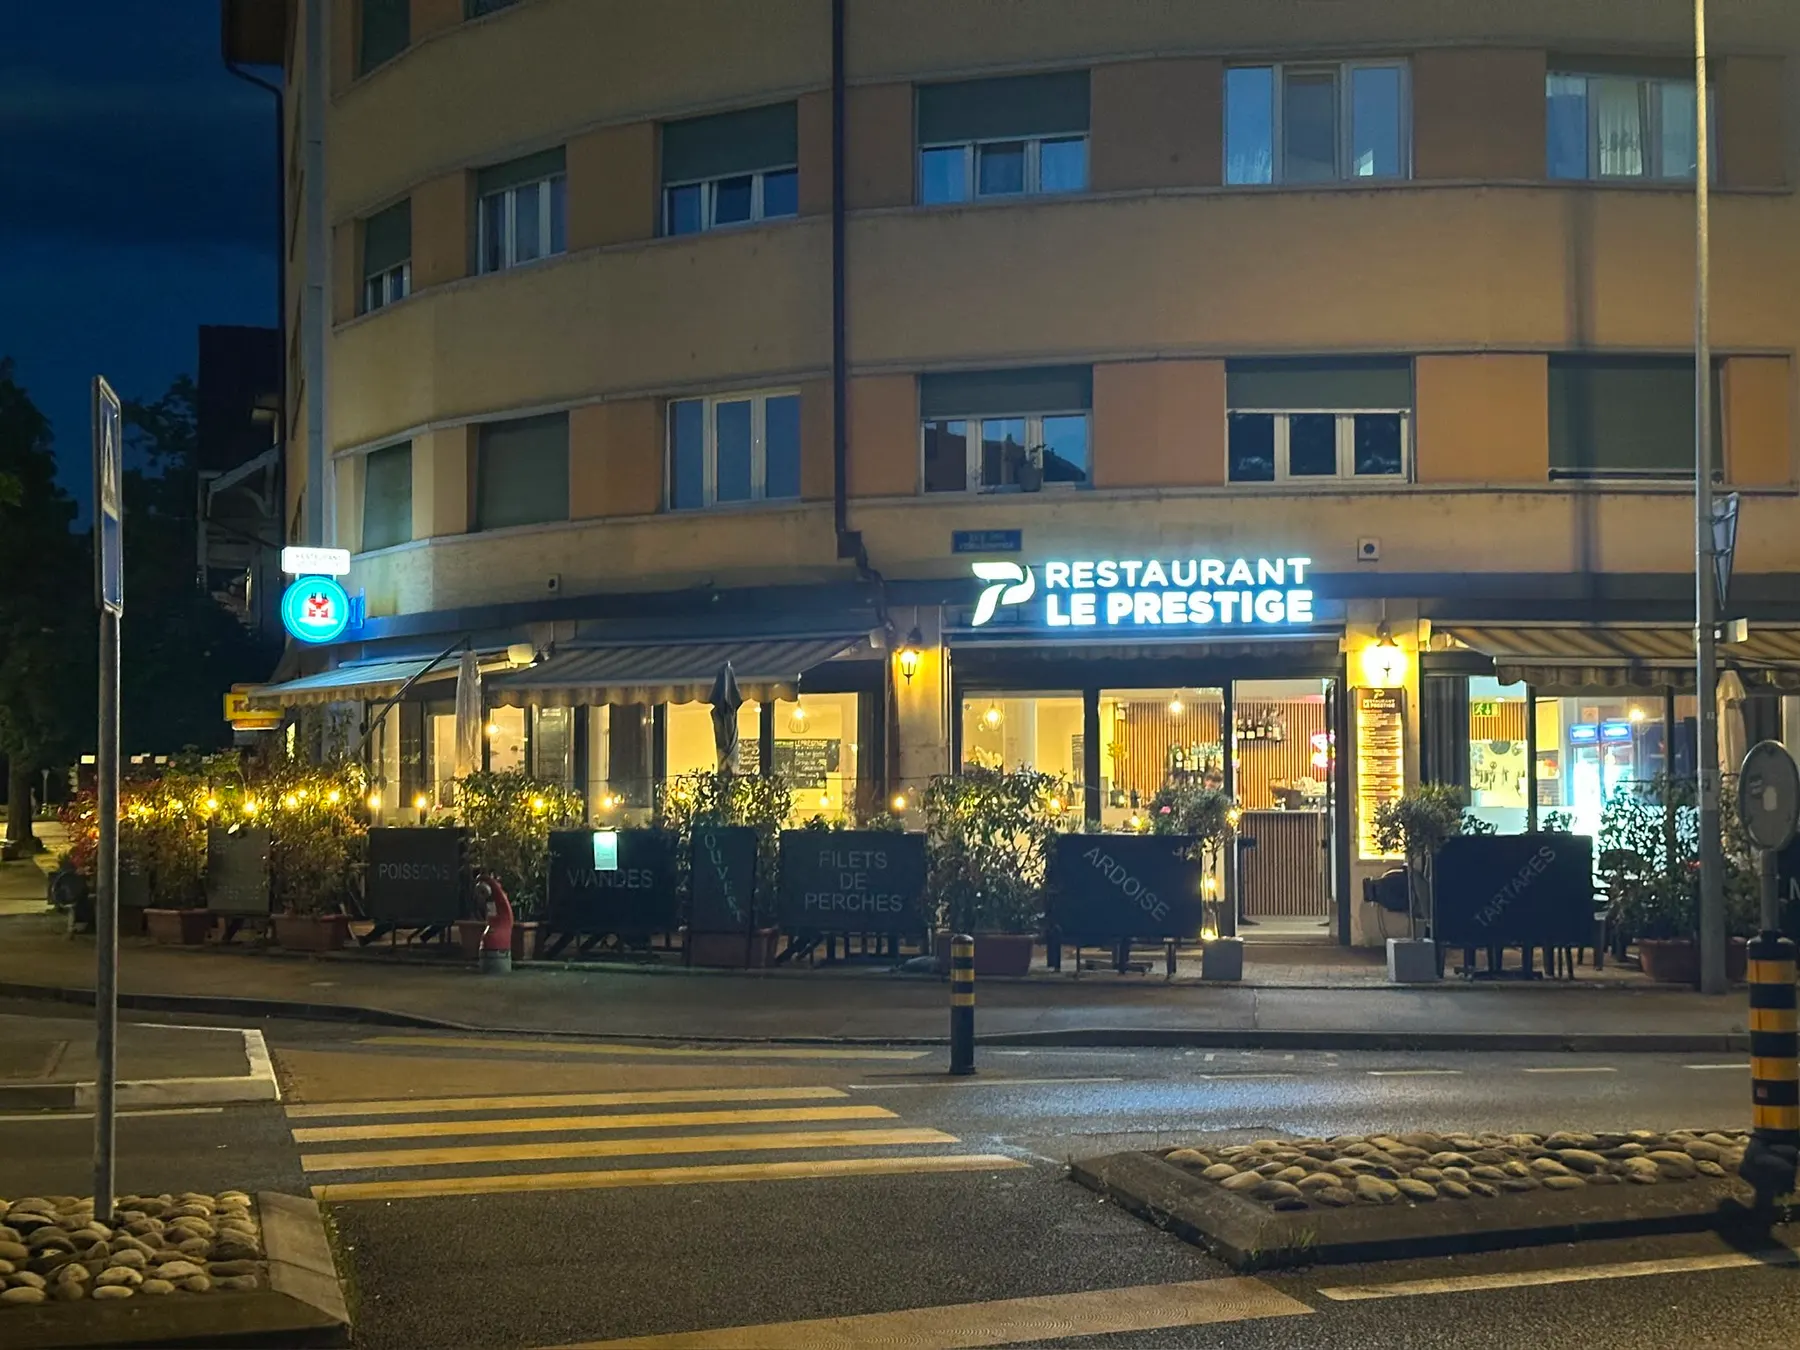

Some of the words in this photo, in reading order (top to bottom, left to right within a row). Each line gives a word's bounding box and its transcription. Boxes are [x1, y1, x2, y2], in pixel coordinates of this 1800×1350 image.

[1045, 557, 1312, 588] RESTAURANT
[1046, 593, 1097, 626] LE
[1107, 590, 1313, 625] PRESTIGE
[818, 850, 888, 869] FILETS
[566, 868, 654, 888] VIANDES
[840, 872, 867, 890] DE
[1082, 847, 1171, 922] ARDOISE
[1471, 845, 1556, 927] TARTARES
[804, 892, 904, 911] PERCHES
